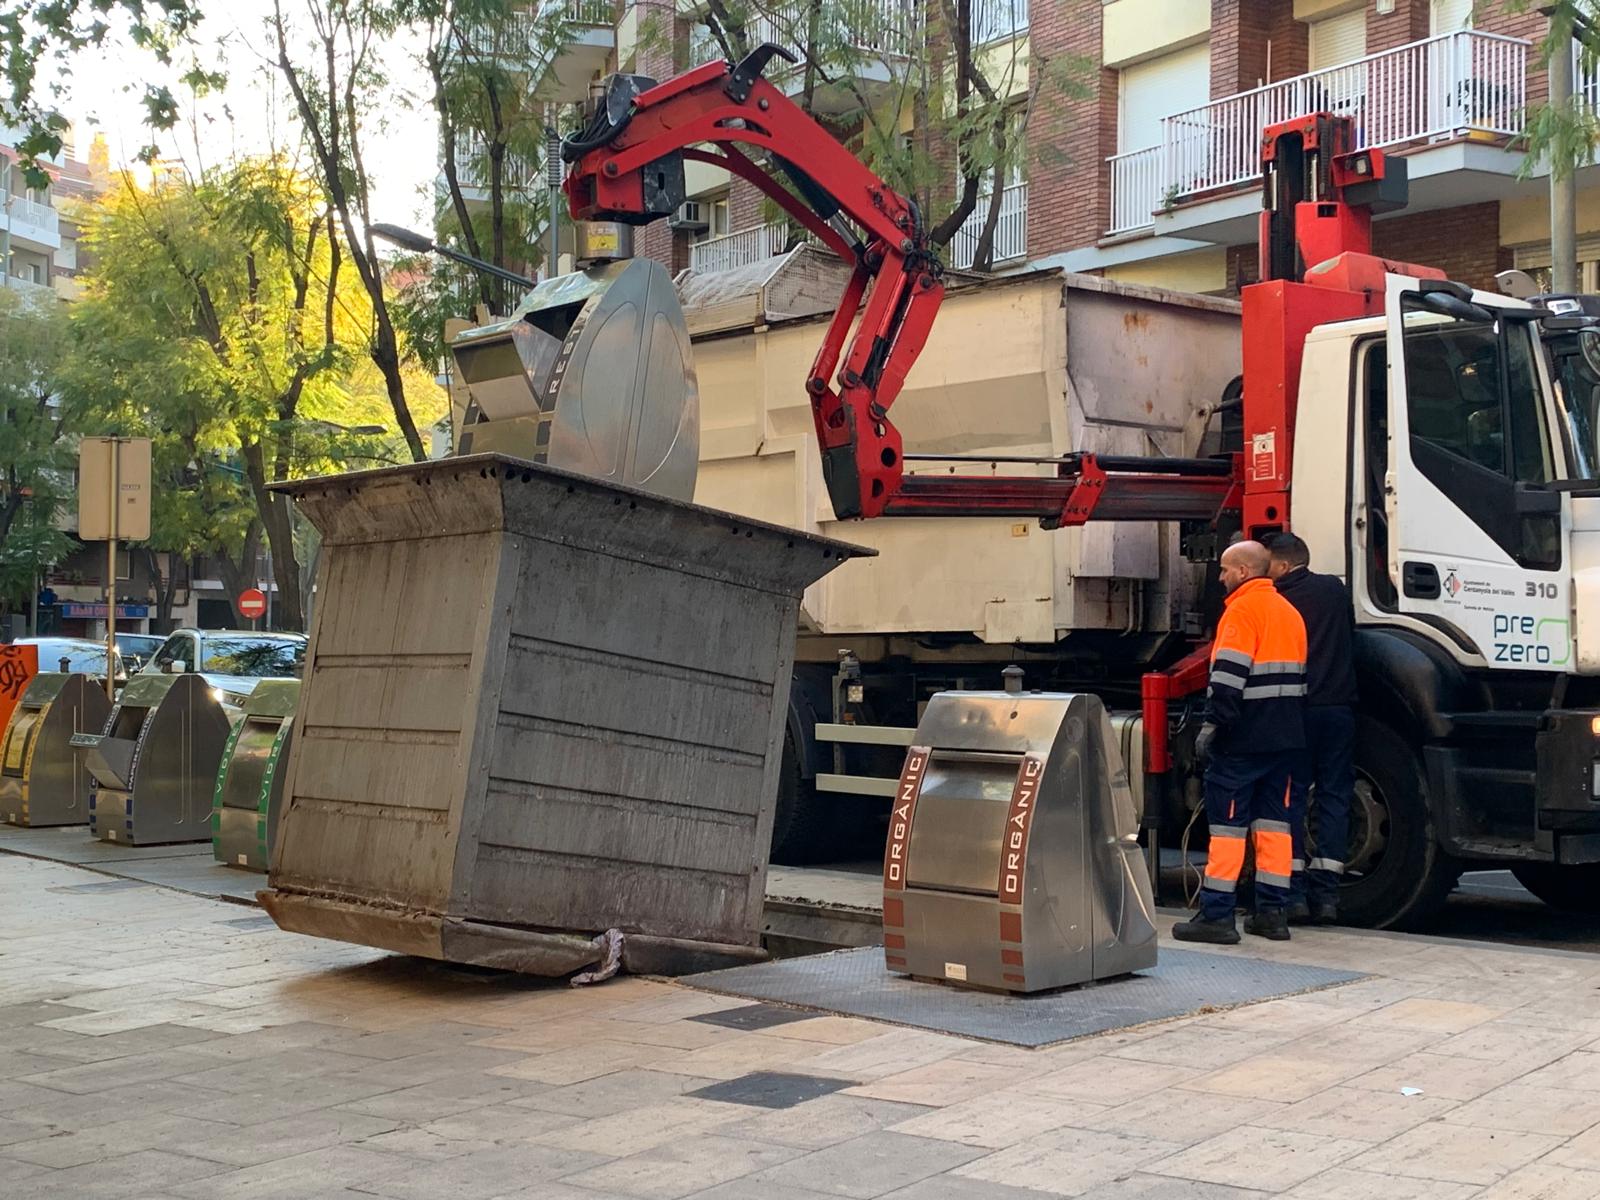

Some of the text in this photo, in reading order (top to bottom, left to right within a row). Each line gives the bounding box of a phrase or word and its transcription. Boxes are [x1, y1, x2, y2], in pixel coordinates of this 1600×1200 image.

[1525, 581, 1558, 599] 310
[1494, 615, 1534, 638] pre
[1494, 643, 1550, 664] zero
[215, 727, 242, 793] VIDRE
[889, 757, 922, 881] ORGÀNIC
[1005, 760, 1041, 893] ORGÀNIC
